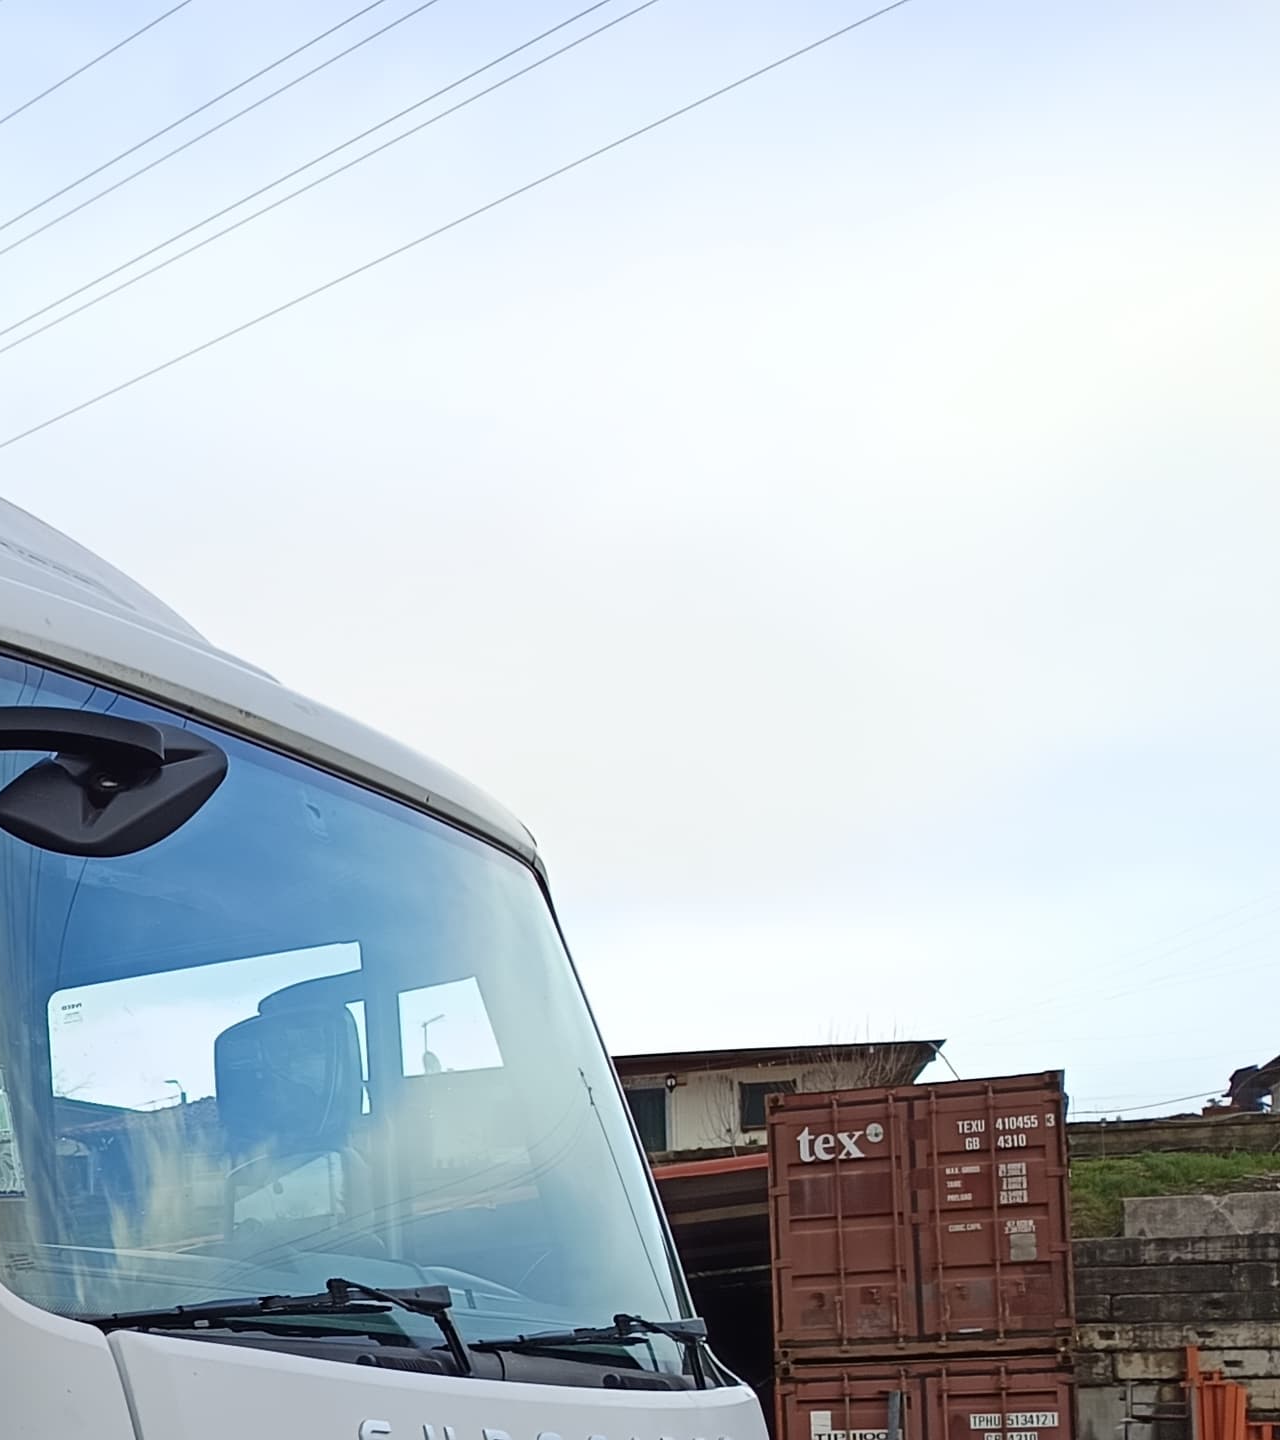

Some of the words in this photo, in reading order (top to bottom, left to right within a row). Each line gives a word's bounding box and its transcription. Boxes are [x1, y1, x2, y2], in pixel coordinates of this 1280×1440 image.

[957, 1120, 985, 1134] TEXU
[995, 1115, 1038, 1130] 410455
[1045, 1114, 1055, 1127] 3
[796, 1126, 866, 1163] tex
[965, 1137, 980, 1151] GB
[997, 1134, 1027, 1149] 4310
[971, 1415, 1001, 1427] TPHU
